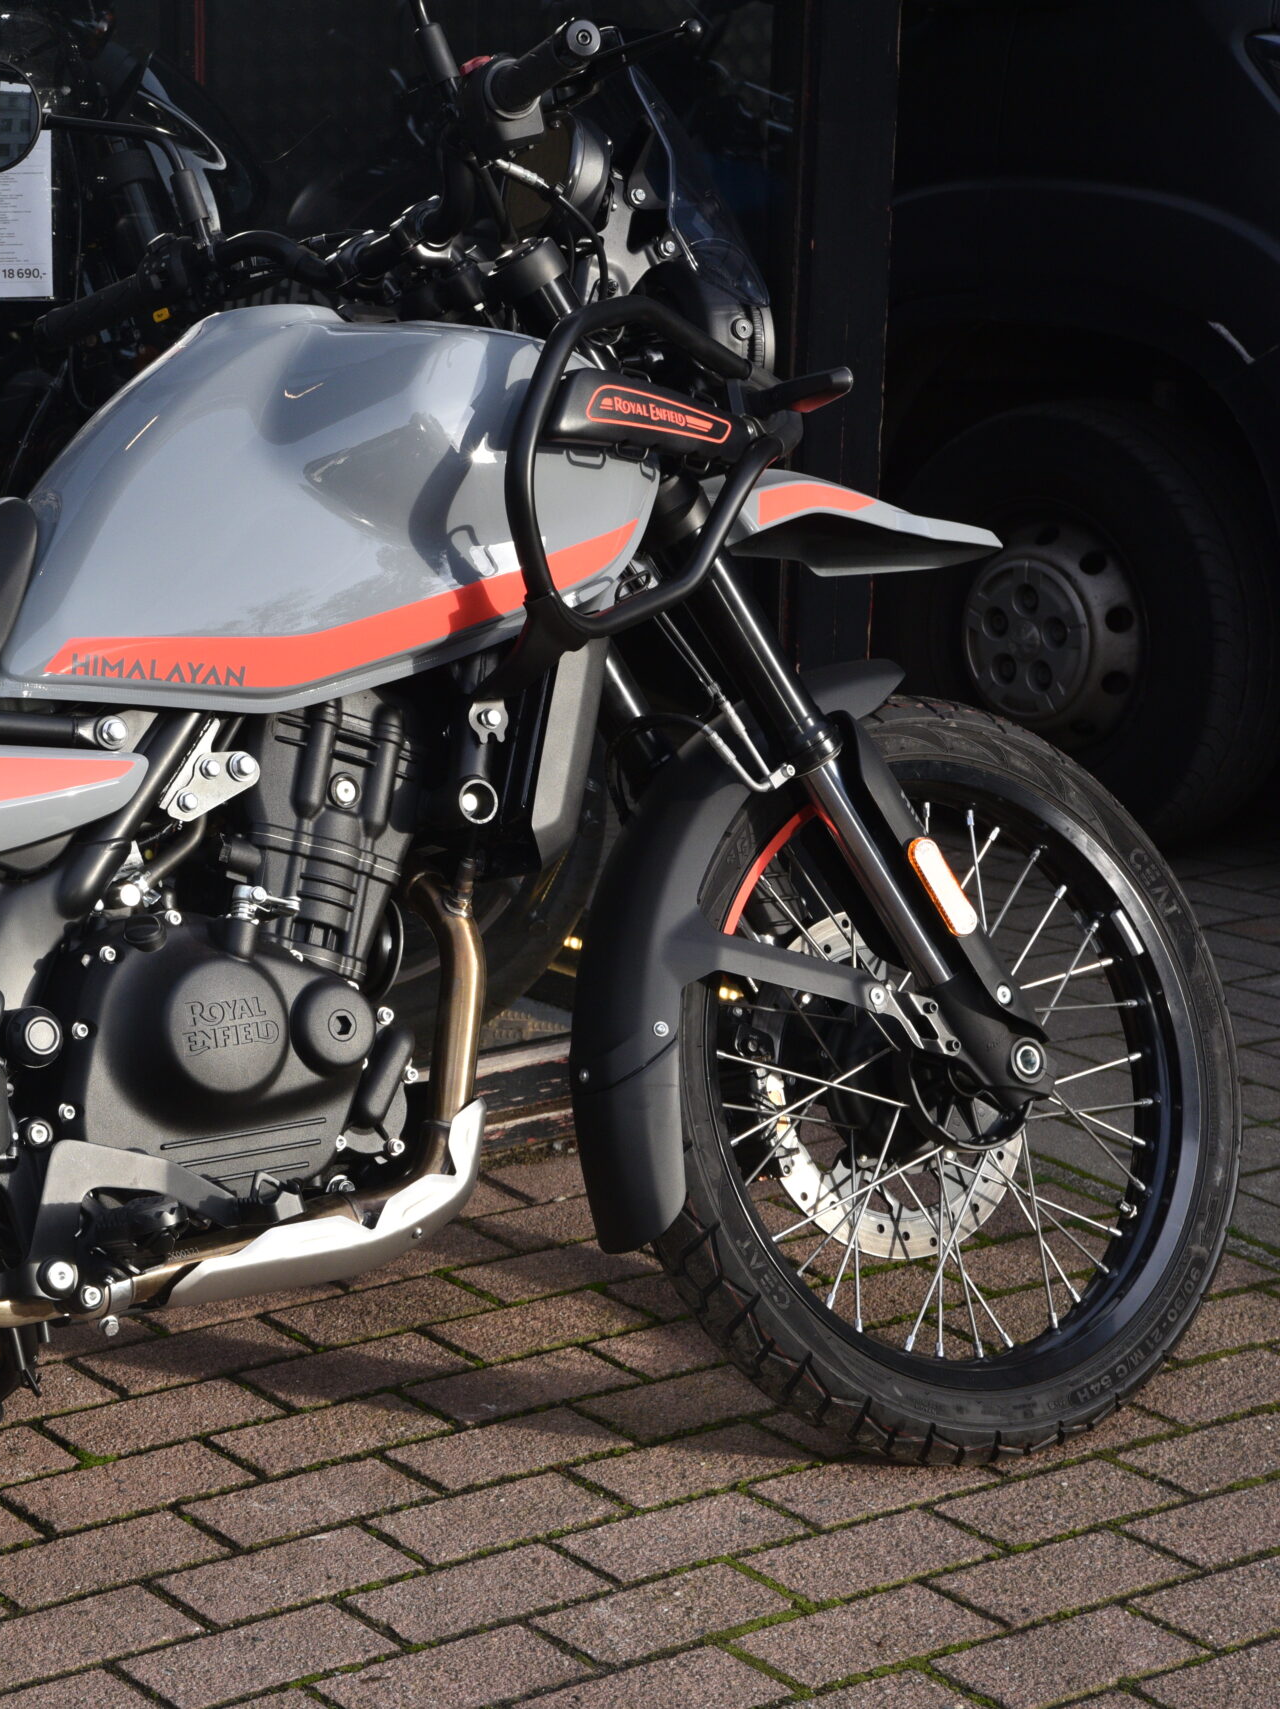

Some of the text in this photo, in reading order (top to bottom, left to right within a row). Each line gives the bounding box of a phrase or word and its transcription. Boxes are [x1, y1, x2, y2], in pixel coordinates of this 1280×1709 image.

[614, 396, 687, 427] ROYAL ENFIELD
[71, 653, 246, 687] HIMALAYAN
[183, 996, 267, 1027] ROYAL
[181, 1020, 280, 1057] ENFIELD
